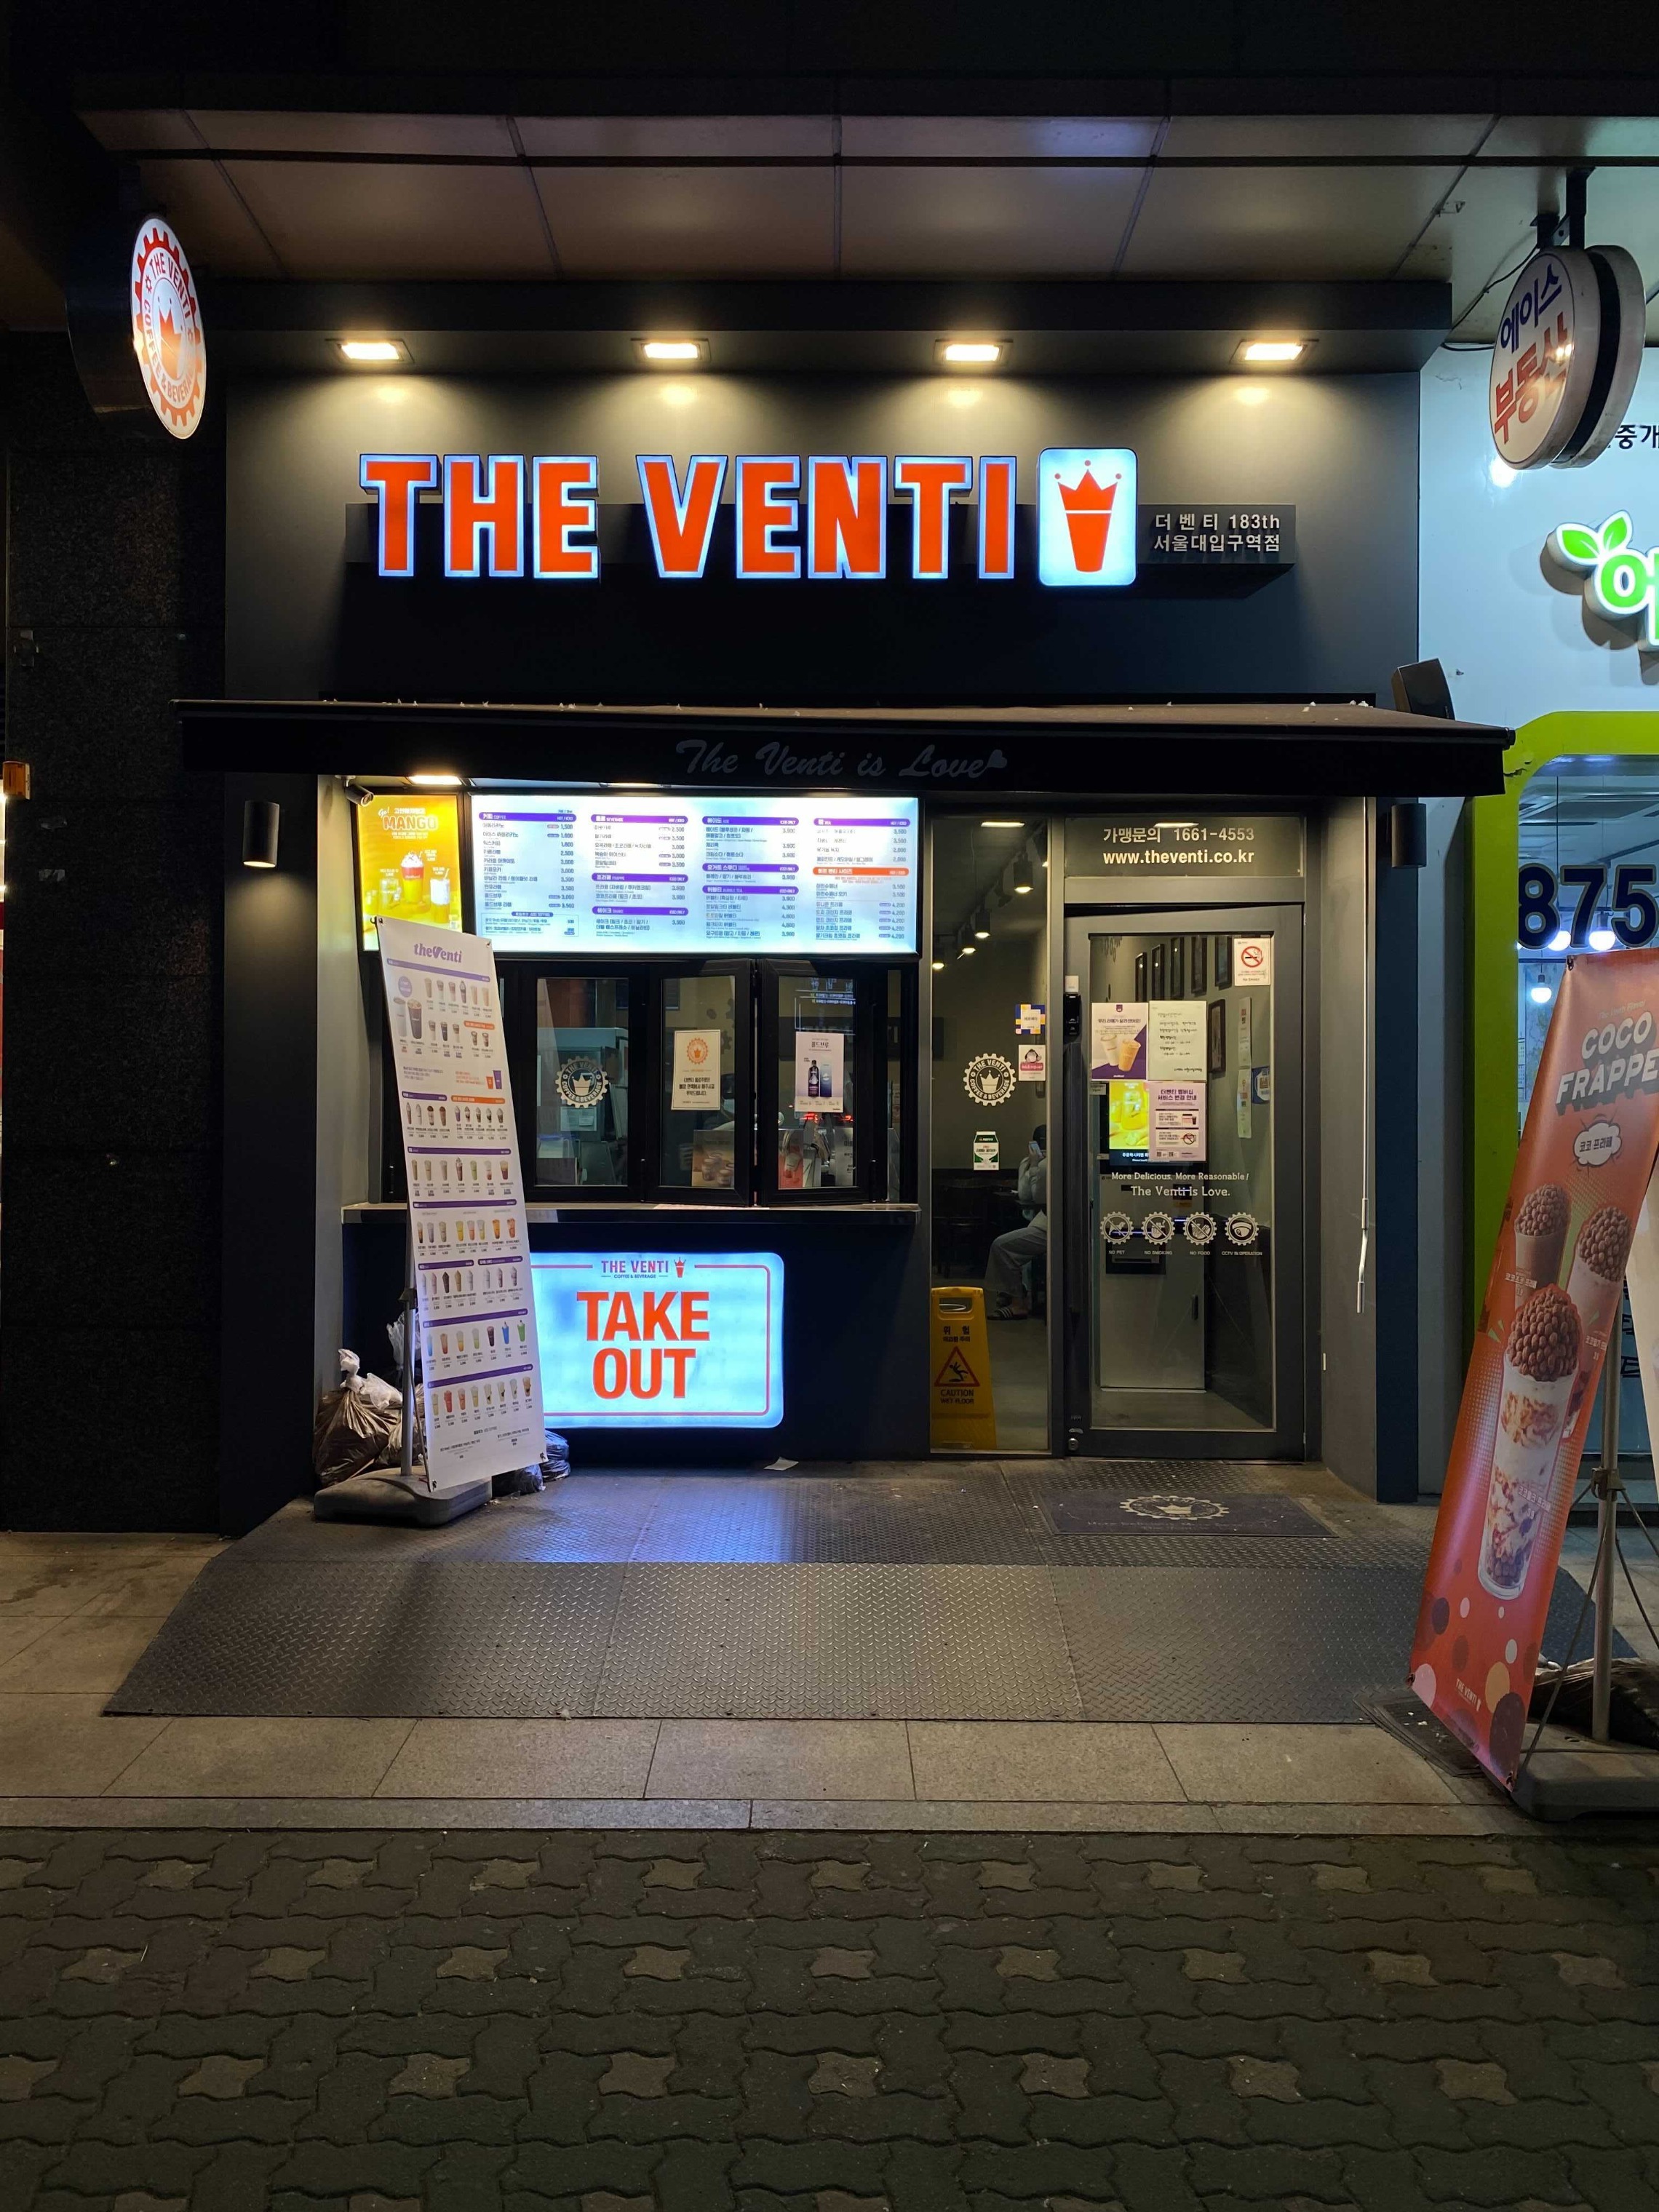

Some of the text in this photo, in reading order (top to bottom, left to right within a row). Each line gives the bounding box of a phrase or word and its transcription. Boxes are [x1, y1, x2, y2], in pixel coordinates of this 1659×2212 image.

[149, 252, 191, 319] THE VENTI
[1500, 263, 1562, 354] 에이스
[144, 299, 162, 379] COFFEE
[1494, 311, 1569, 445] 부동산
[359, 454, 1019, 580] THE VENTI
[1229, 514, 1280, 530] 183th
[1154, 534, 1280, 552] 서울대입구역점
[676, 739, 985, 779] The Venti is Love
[383, 815, 439, 831] MANGO
[1103, 827, 1255, 843] 가맹문의 1661-4553
[1102, 849, 1255, 864] www.theventi.co.kr
[1519, 863, 1659, 950] 875
[1581, 1011, 1653, 1060] COCO
[973, 1059, 986, 1073] THE
[987, 1059, 1006, 1073] VENTI
[969, 1079, 983, 1098] COFFEE
[987, 1079, 1010, 1100] BEVERAGE
[1579, 1139, 1592, 1153] 코코
[1111, 1172, 1132, 1180] More
[1175, 1172, 1195, 1180] More
[1130, 1186, 1152, 1196] The
[1155, 1186, 1186, 1196] Venti
[1201, 1186, 1231, 1197] Love.
[600, 1260, 669, 1273] THE VENTI
[576, 1292, 710, 1341] TAKE
[592, 1348, 696, 1399] OUT
[940, 1389, 974, 1397] CAUTION
